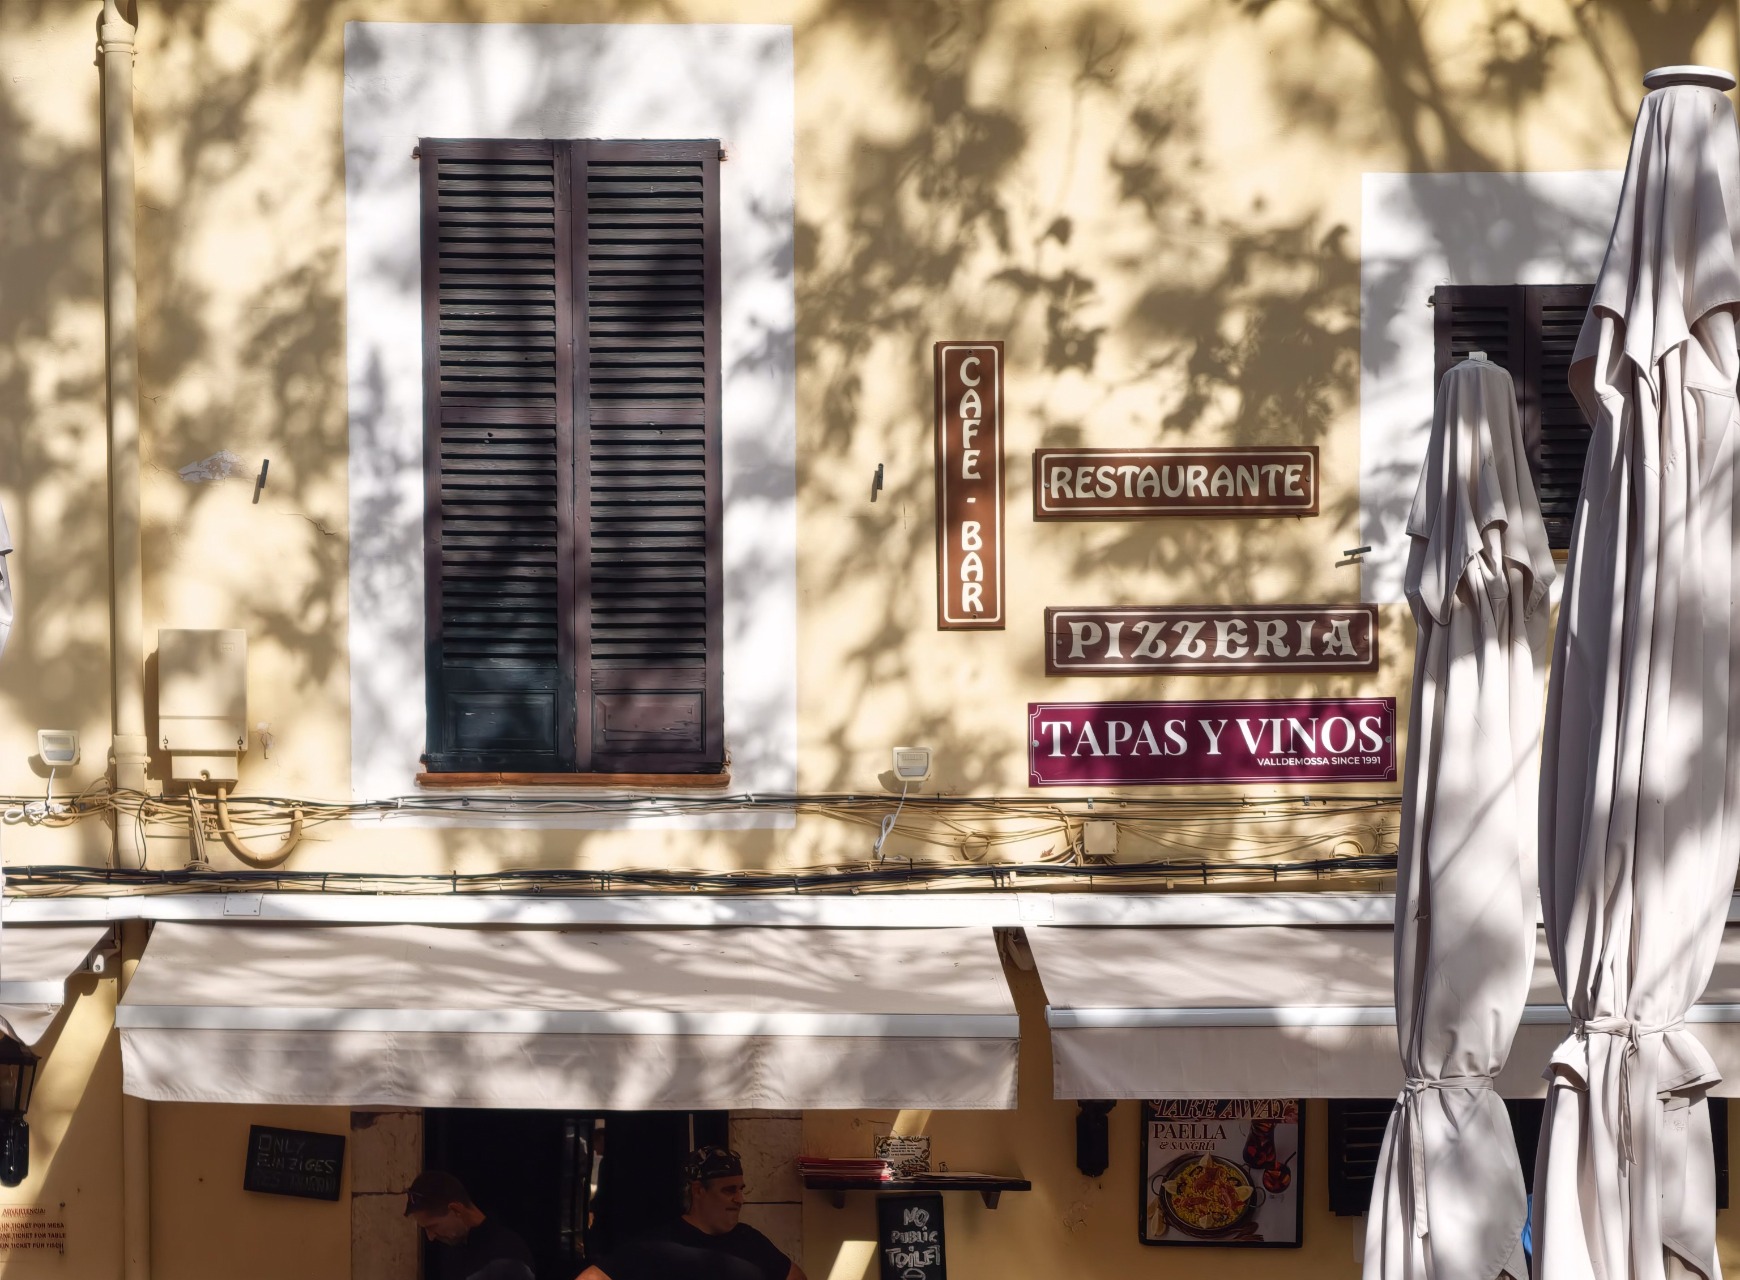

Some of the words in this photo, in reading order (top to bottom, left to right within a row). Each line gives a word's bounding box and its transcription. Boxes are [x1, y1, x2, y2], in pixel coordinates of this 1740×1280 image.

[958, 356, 982, 480] CAFE
[1050, 464, 1305, 499] RESTAURANTE
[960, 520, 984, 613] BAR
[1067, 618, 1358, 660] PIZZERIA
[1041, 719, 1188, 757] TAPAS
[1198, 717, 1228, 756] Y
[1236, 715, 1384, 755] VINOS
[1257, 757, 1330, 766] VALLDEMOSSA
[1331, 757, 1360, 765] SINCE
[1362, 756, 1381, 765] 1991
[1154, 1099, 1217, 1118] TAKE
[1219, 1099, 1294, 1120] AWAY
[1153, 1123, 1227, 1140] PAELLA
[903, 1207, 930, 1227] NO
